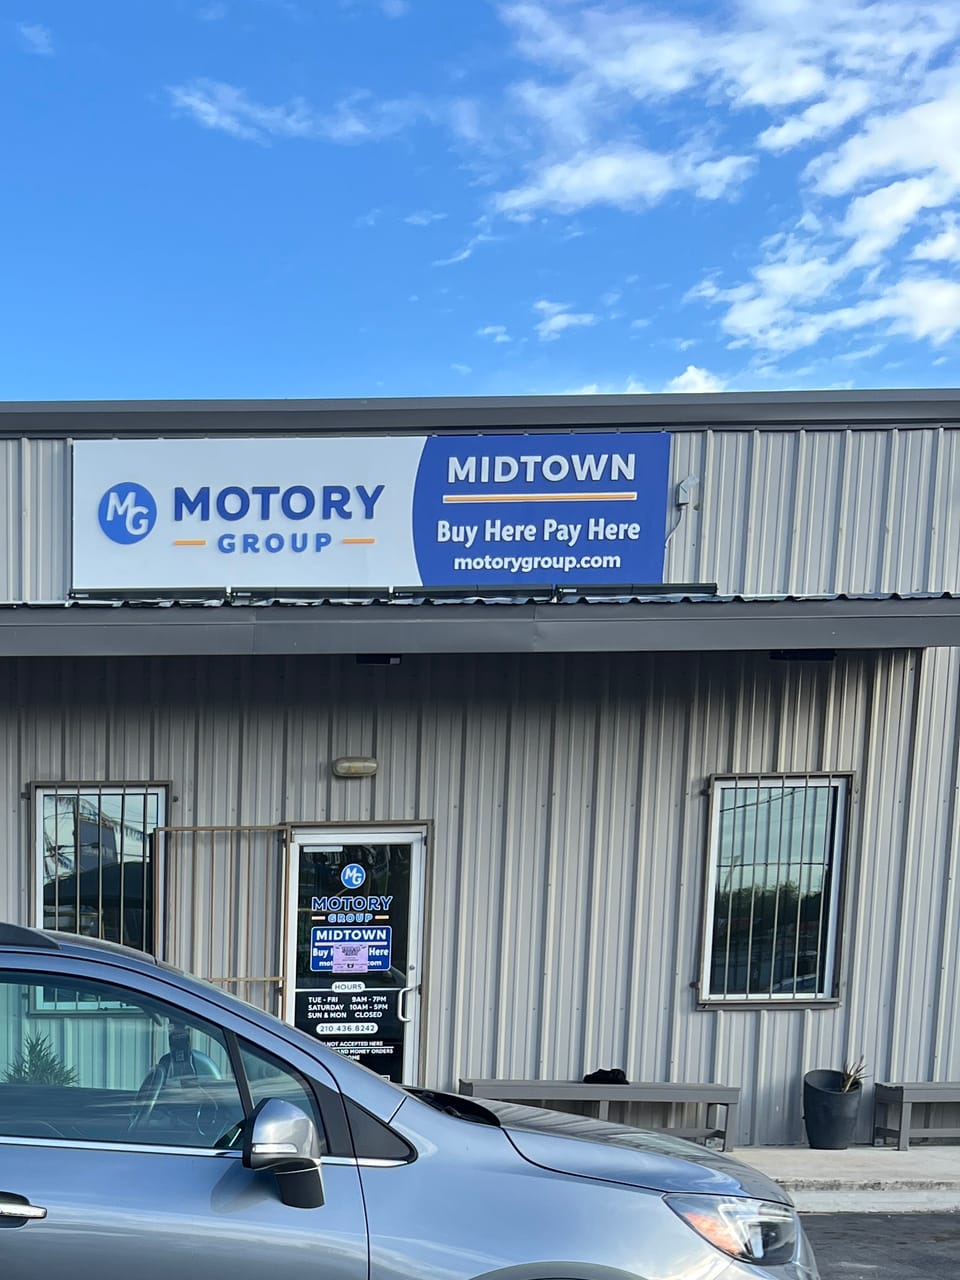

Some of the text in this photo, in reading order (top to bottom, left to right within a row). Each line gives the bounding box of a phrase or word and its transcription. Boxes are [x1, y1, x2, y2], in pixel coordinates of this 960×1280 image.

[448, 454, 635, 483] MIDTOWN
[174, 485, 385, 521] MOTORY
[106, 491, 149, 535] MG
[437, 518, 640, 548] Buy Here Pay Here
[218, 533, 332, 553] GROUP
[454, 555, 621, 572] motorygroup.com
[345, 868, 362, 885] MG
[312, 896, 393, 911] MOTORY
[328, 913, 373, 923] GROUP
[316, 930, 386, 940] MIDTOWN
[312, 948, 328, 958] Buy
[369, 947, 389, 956] Here
